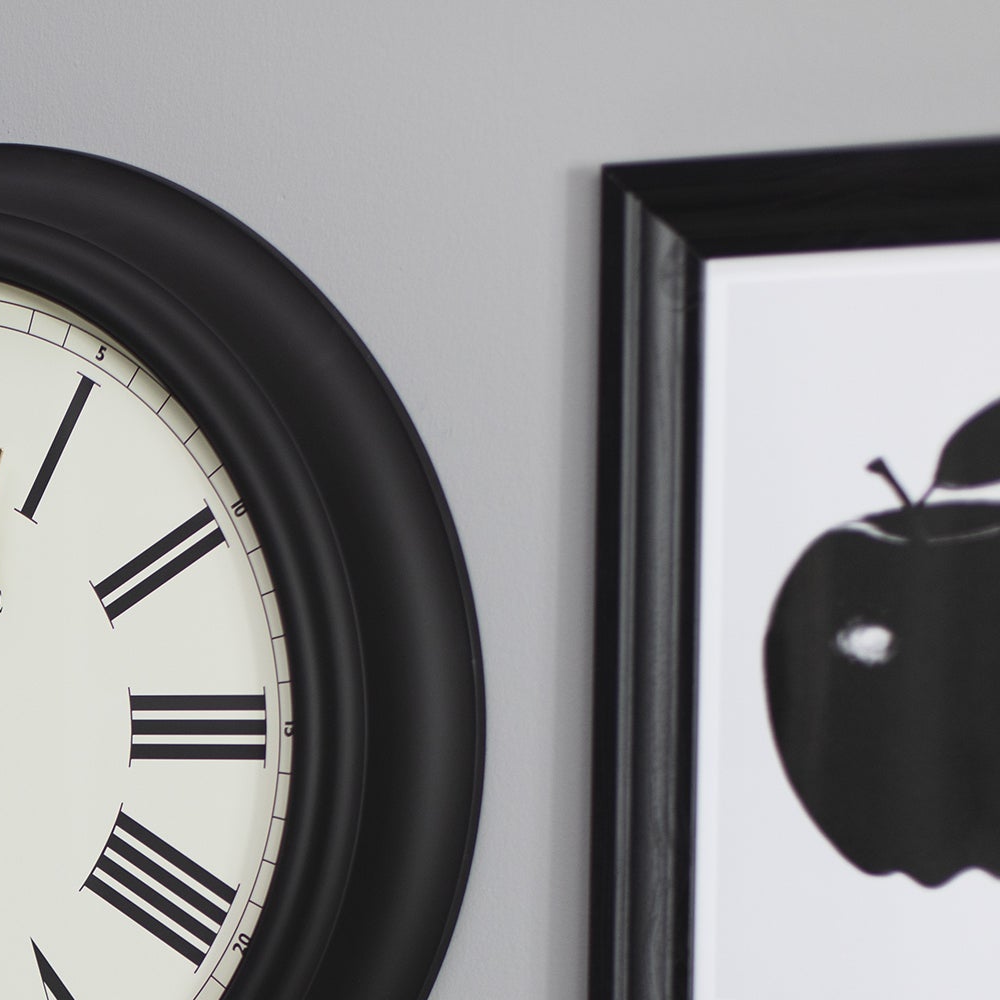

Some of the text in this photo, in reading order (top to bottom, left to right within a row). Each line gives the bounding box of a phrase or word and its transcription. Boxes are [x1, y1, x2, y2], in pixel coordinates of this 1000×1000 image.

[95, 345, 107, 361] 5
[231, 501, 248, 518] 10
[232, 932, 251, 956] 20
